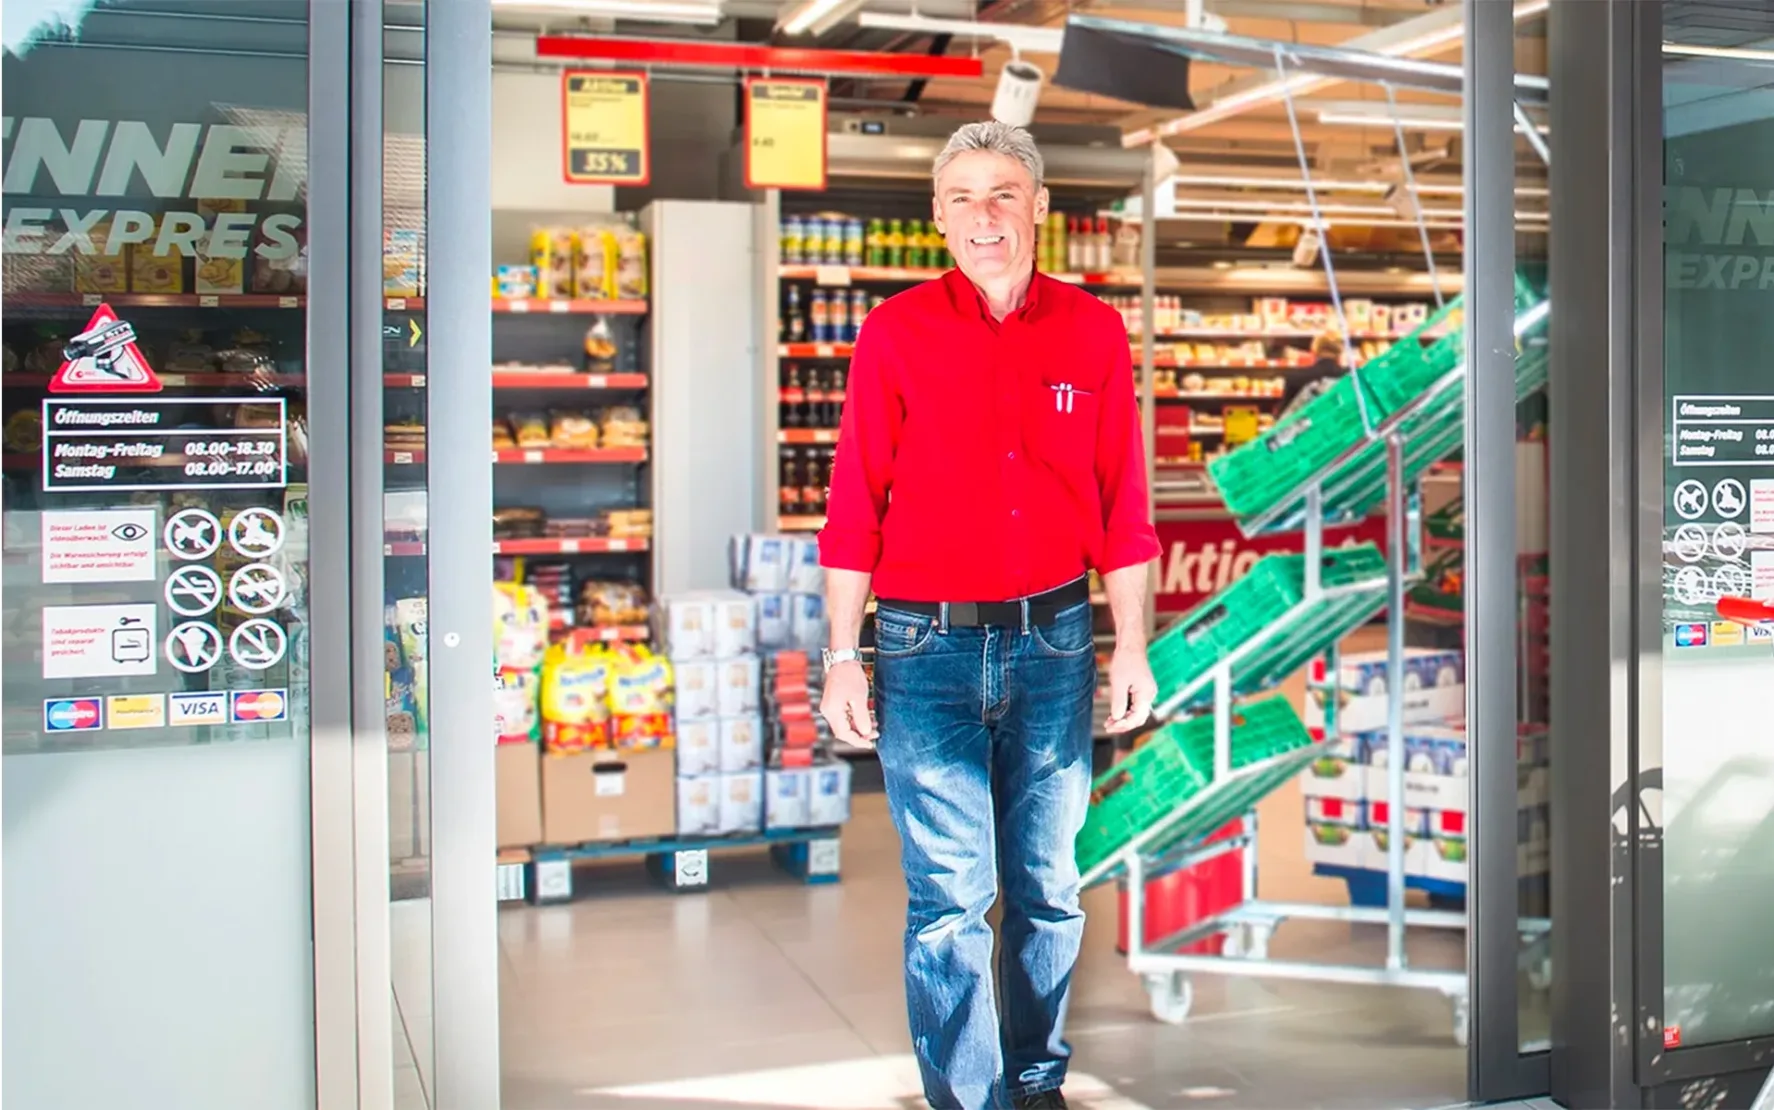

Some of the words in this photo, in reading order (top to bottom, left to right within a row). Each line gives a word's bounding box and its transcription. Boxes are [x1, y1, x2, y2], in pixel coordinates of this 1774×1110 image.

[2, 116, 307, 200] NNE
[2, 207, 307, 260] EXPRES
[54, 408, 159, 426] Öffnungszeiten
[54, 443, 163, 458] Montag-Freitag
[54, 464, 116, 479] Samstag
[181, 702, 219, 715] VISA
